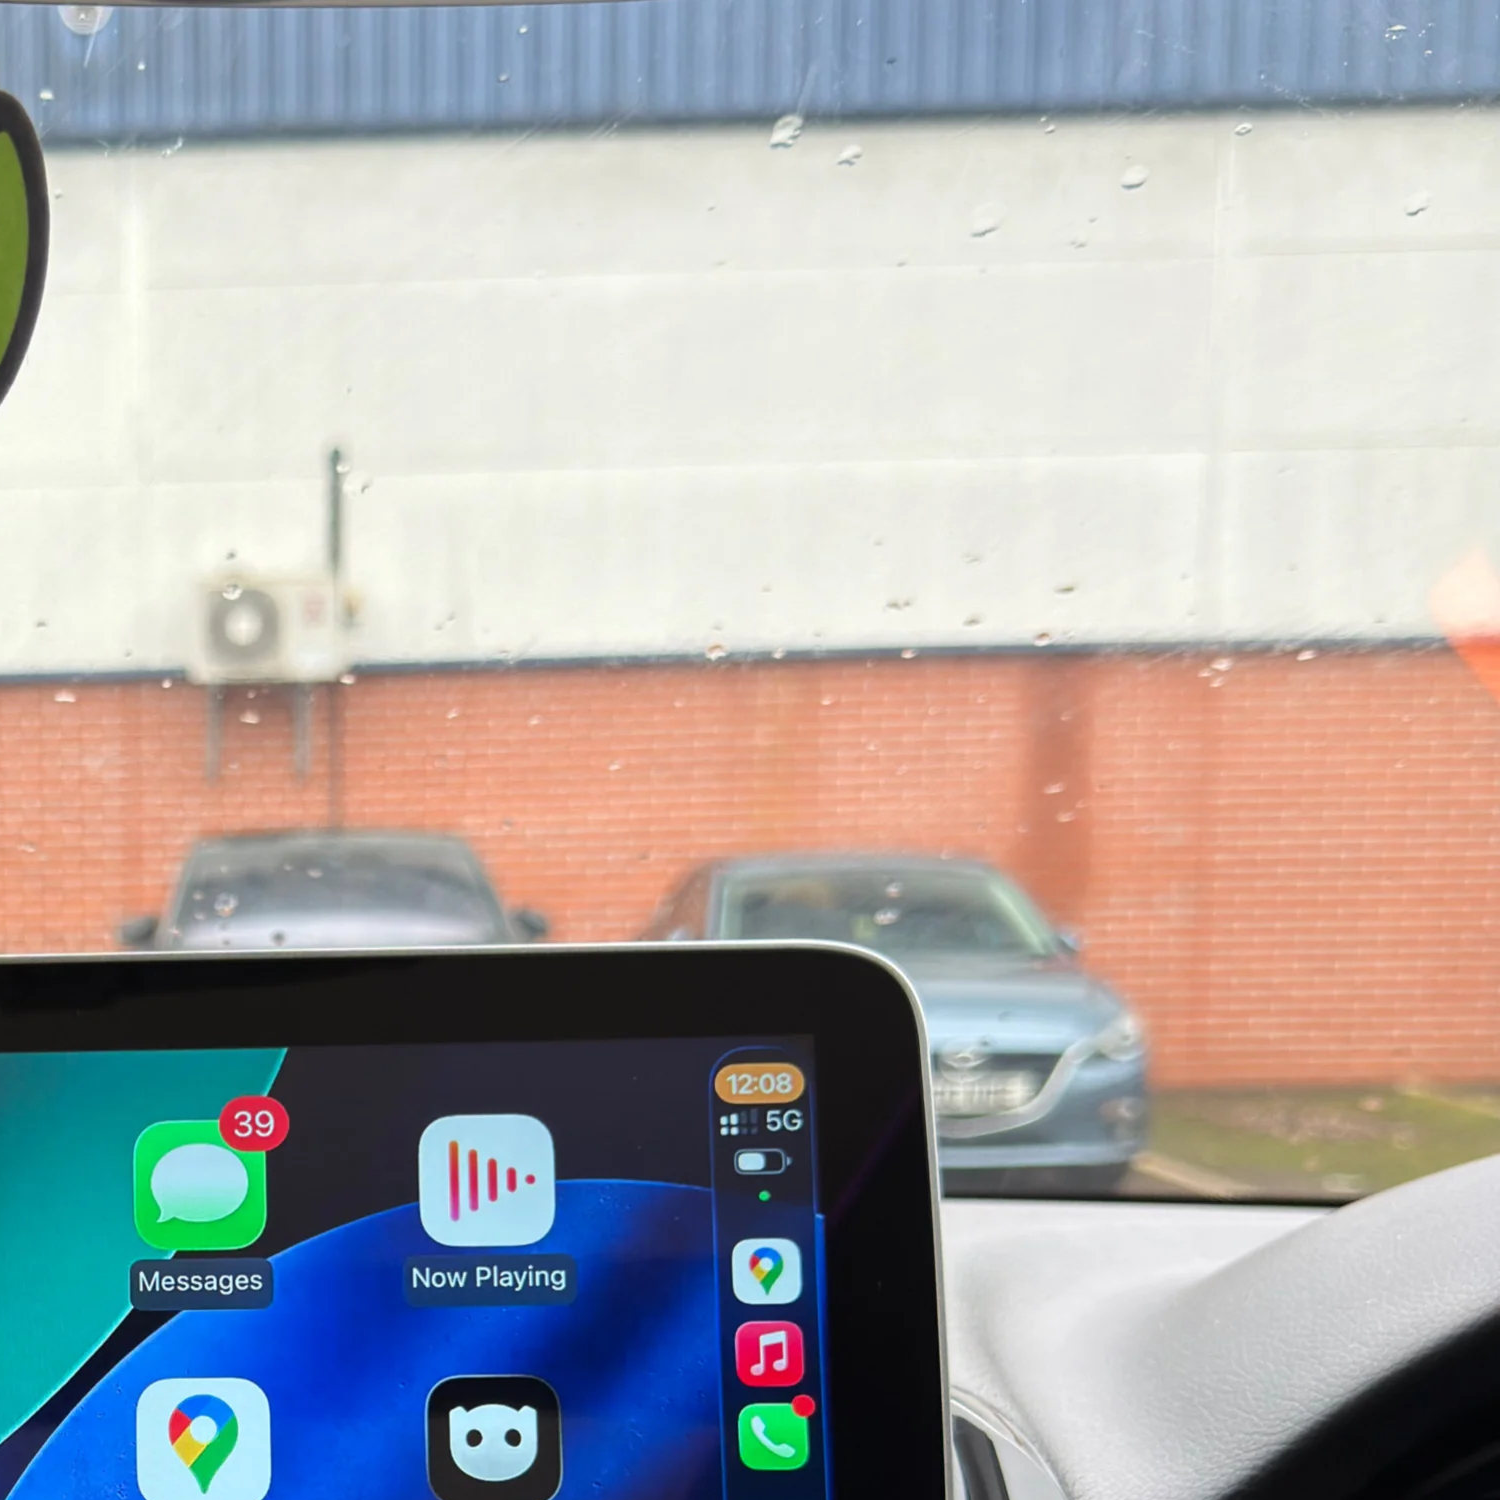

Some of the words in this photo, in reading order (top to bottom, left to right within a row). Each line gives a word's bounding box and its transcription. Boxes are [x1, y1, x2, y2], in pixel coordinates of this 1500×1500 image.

[725, 1072, 793, 1095] 12:08
[234, 1110, 275, 1138] 39
[766, 1109, 803, 1132] 5G
[138, 1270, 263, 1296] Messages
[412, 1267, 467, 1289] Now
[475, 1264, 566, 1292] Playing
